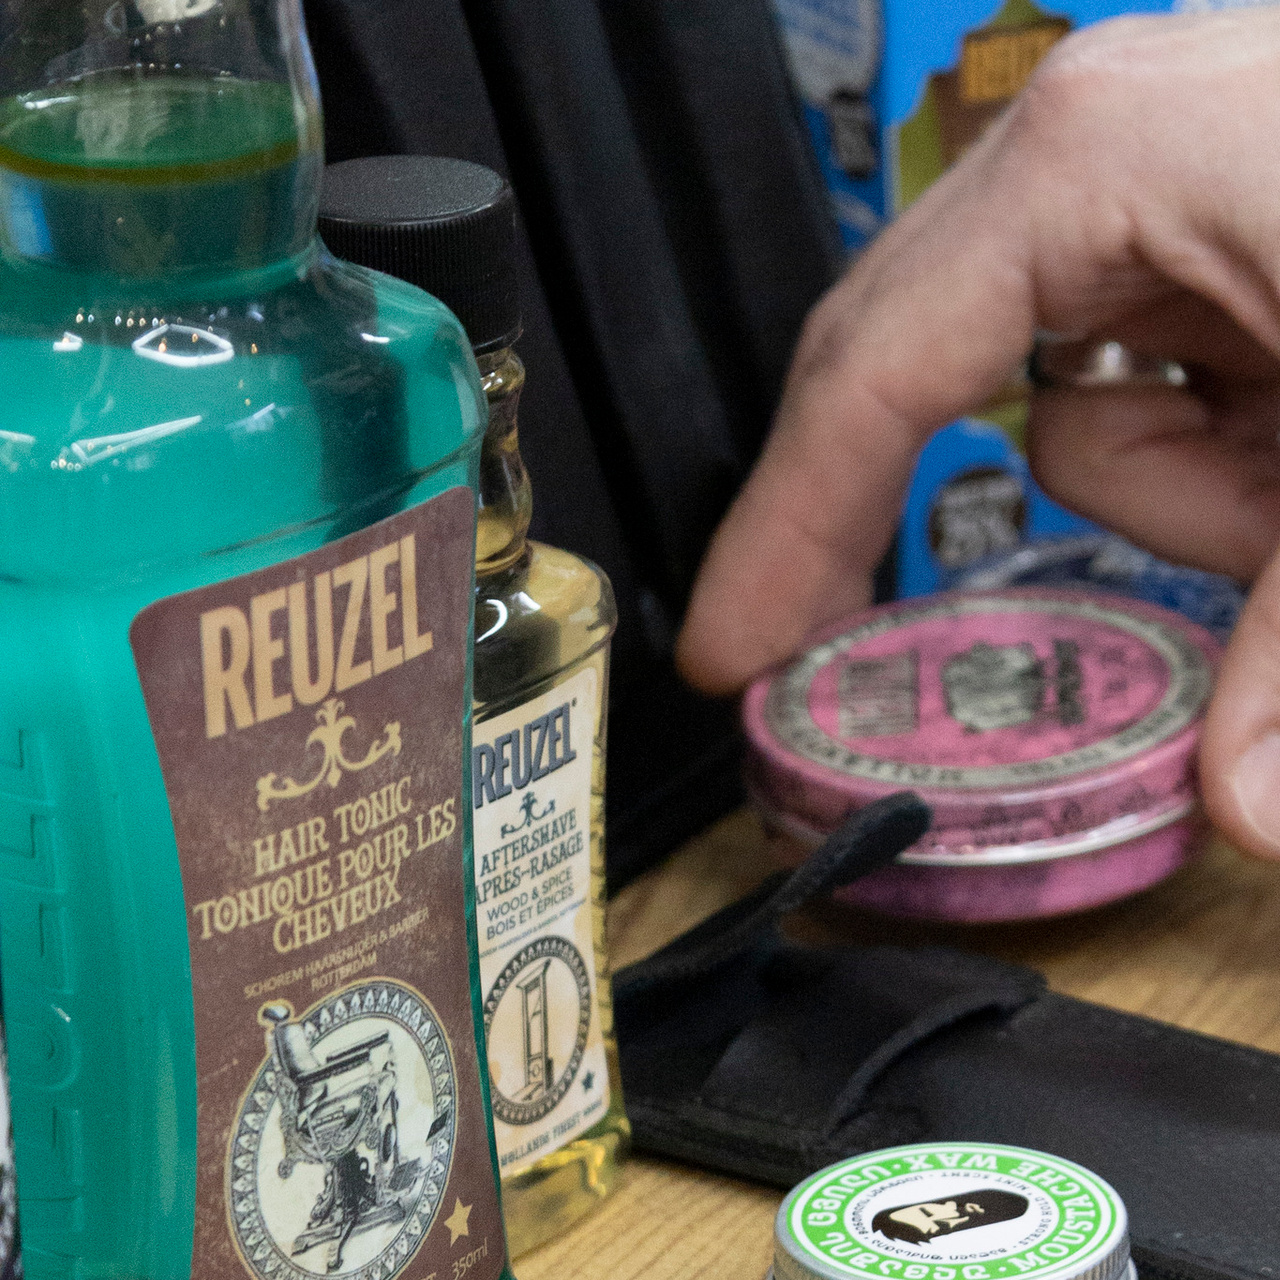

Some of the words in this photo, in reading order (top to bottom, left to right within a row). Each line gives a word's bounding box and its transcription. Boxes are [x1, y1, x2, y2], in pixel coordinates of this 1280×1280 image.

[201, 532, 433, 739] REUZEL
[473, 702, 577, 810] REUZEL
[253, 816, 329, 877] HAIR
[333, 776, 412, 844] TONIC
[480, 808, 577, 877] AFTERSHAVE
[192, 859, 333, 940] TONIQUE
[338, 823, 411, 890] POUR
[415, 797, 456, 852] LES
[487, 892, 528, 922] WOOD
[531, 887, 539, 900] &
[542, 866, 573, 894] SPICE
[273, 861, 401, 954] CHEVEUX
[487, 914, 516, 941] BOIS
[519, 908, 533, 926] ET
[902, 1152, 999, 1171] WAX
[940, 1171, 990, 1180] SCENT
[998, 1175, 1030, 1191] MINT
[807, 1165, 892, 1227] ცვილი
[1008, 1160, 1097, 1272] MOUSTACHE
[1019, 1219, 1052, 1247] STRONG
